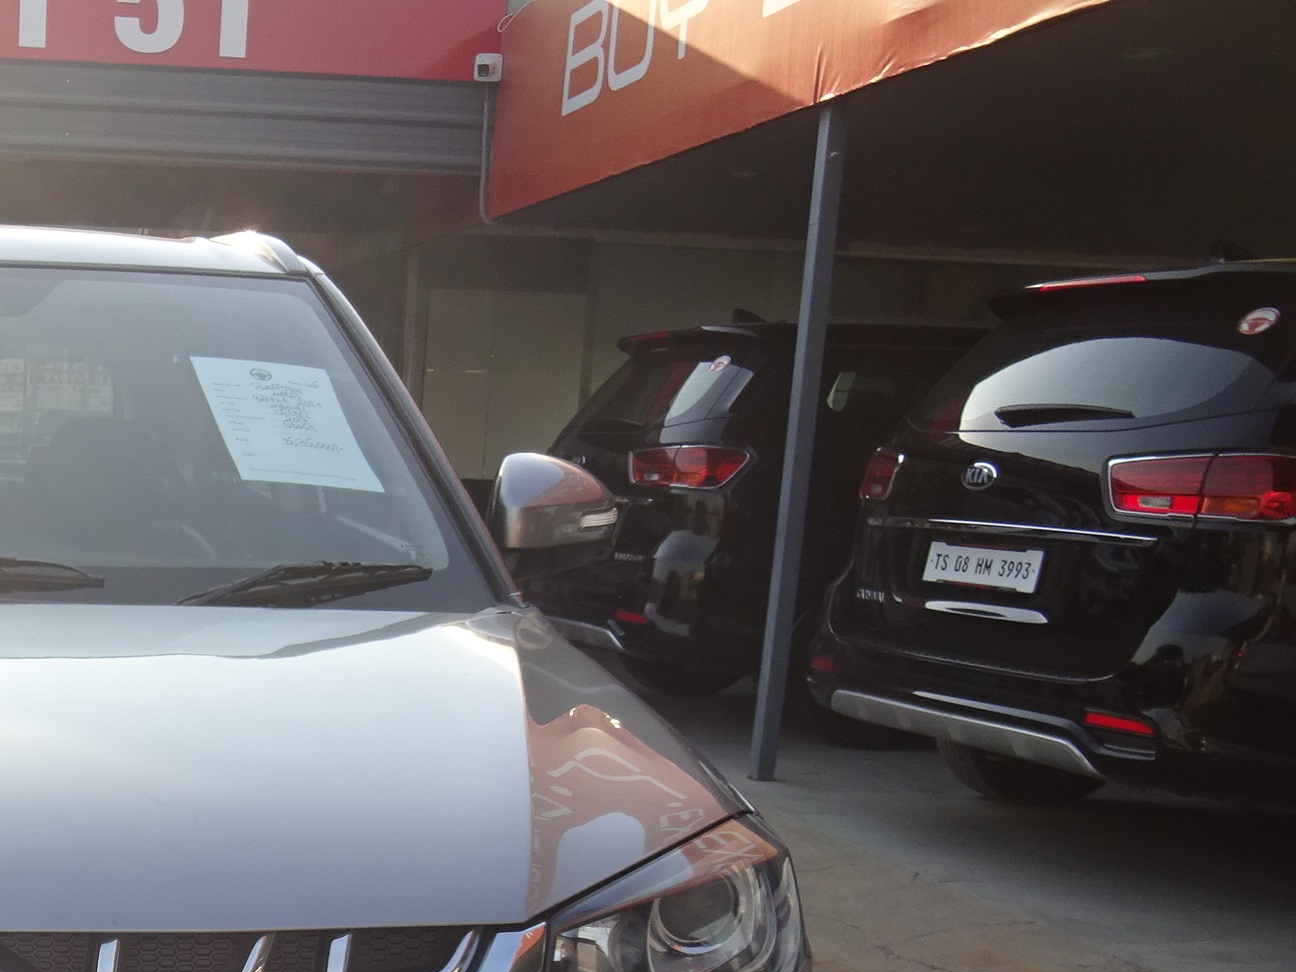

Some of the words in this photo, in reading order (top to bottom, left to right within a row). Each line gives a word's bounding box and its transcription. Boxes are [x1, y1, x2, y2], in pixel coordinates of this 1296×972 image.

[935, 553, 949, 571] TS
[954, 556, 969, 573] 08
[974, 557, 994, 576] HM
[998, 560, 1032, 579] 3993
